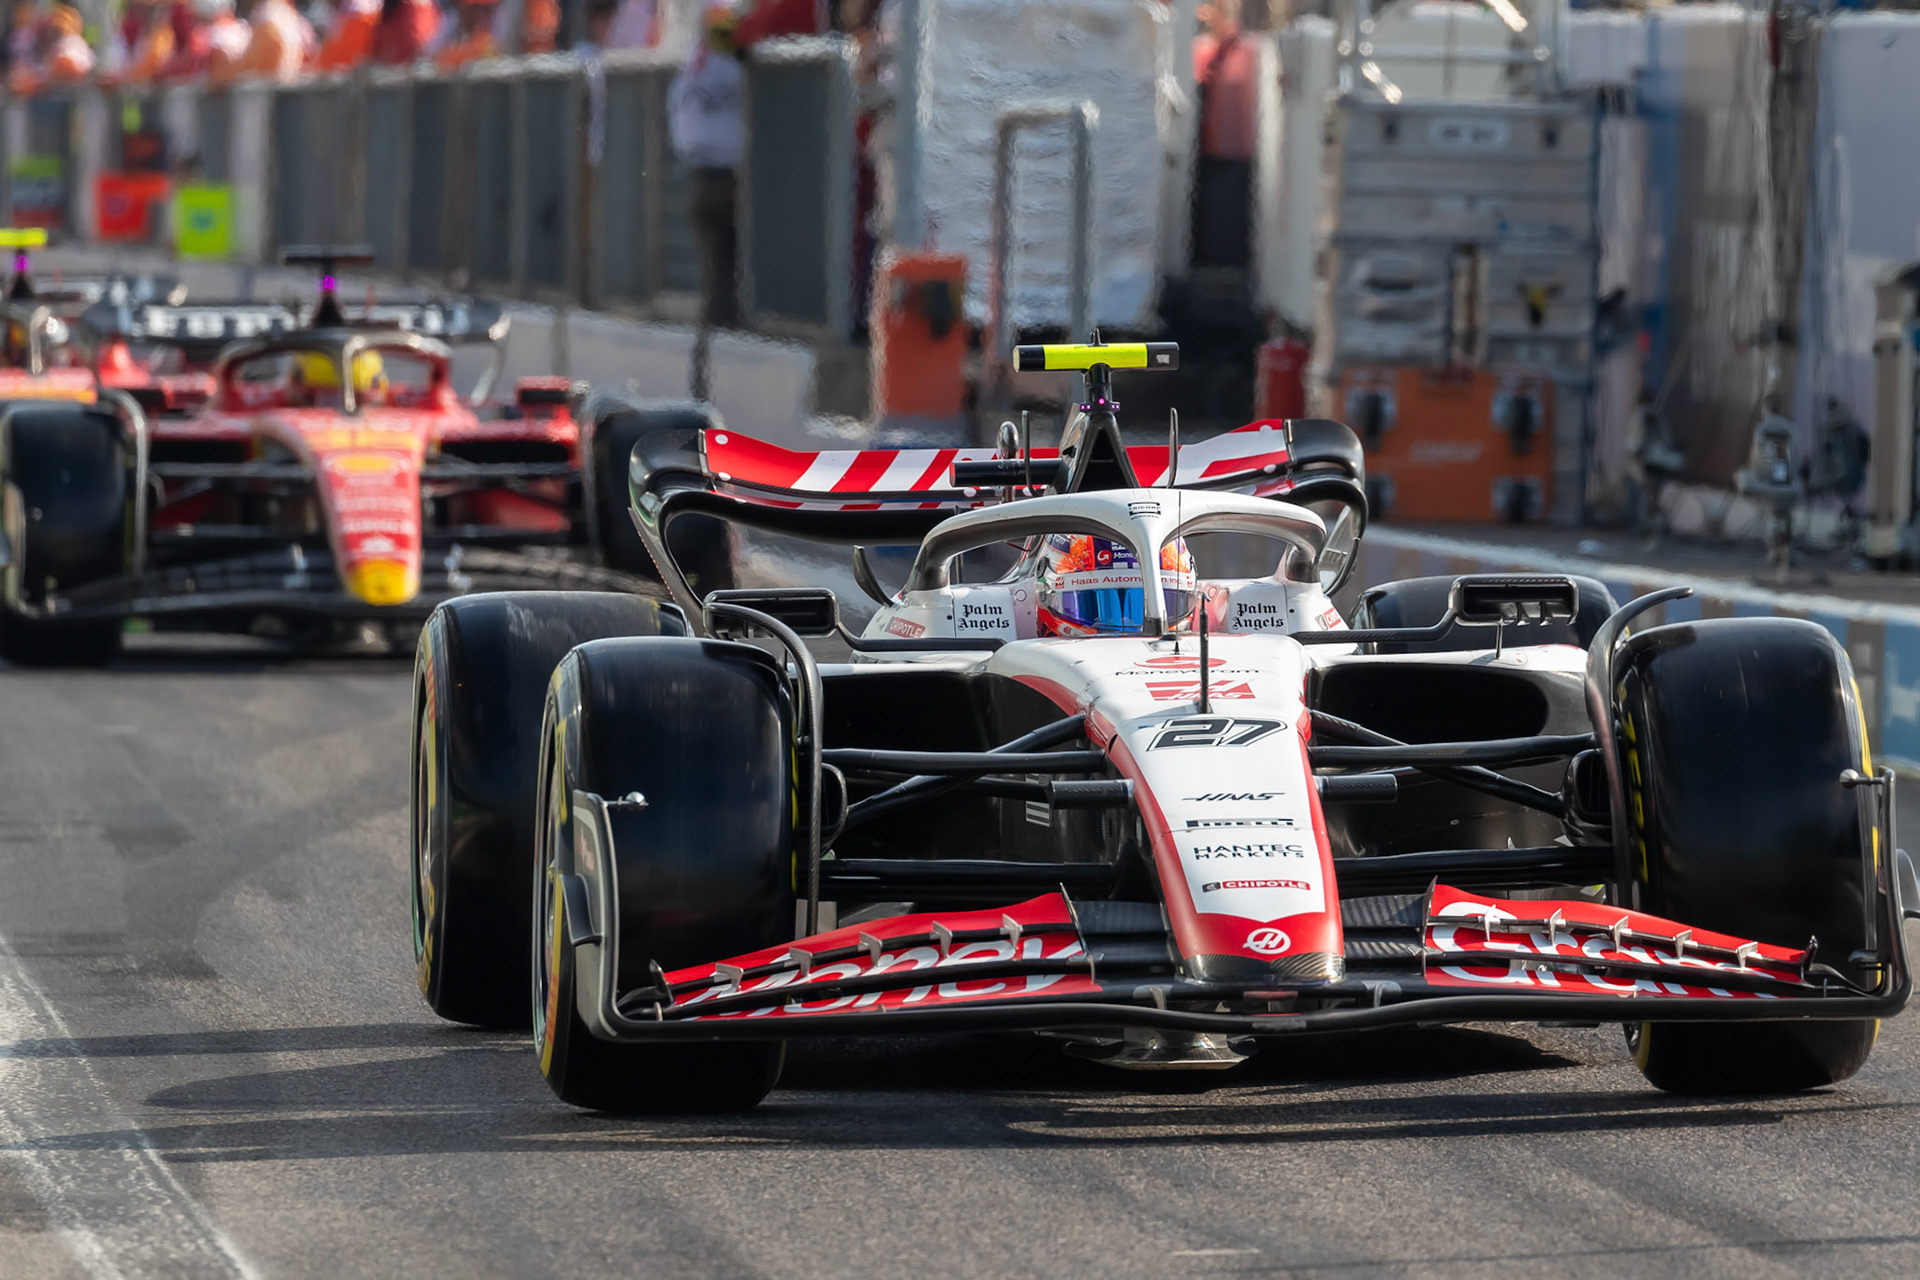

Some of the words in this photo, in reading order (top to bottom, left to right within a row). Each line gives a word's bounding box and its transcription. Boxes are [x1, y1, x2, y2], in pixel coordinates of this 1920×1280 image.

[1071, 577, 1099, 586] Haas
[962, 604, 1002, 618] Palm
[1236, 603, 1277, 617] Palm
[958, 618, 1010, 631] Angels
[1232, 617, 1284, 630] Angels
[1146, 717, 1288, 752] 27
[1182, 793, 1285, 801] HAAS
[1194, 844, 1304, 854] HANTEC
[1195, 852, 1304, 860] MARKETS
[1226, 881, 1308, 890] CHIPOTLE
